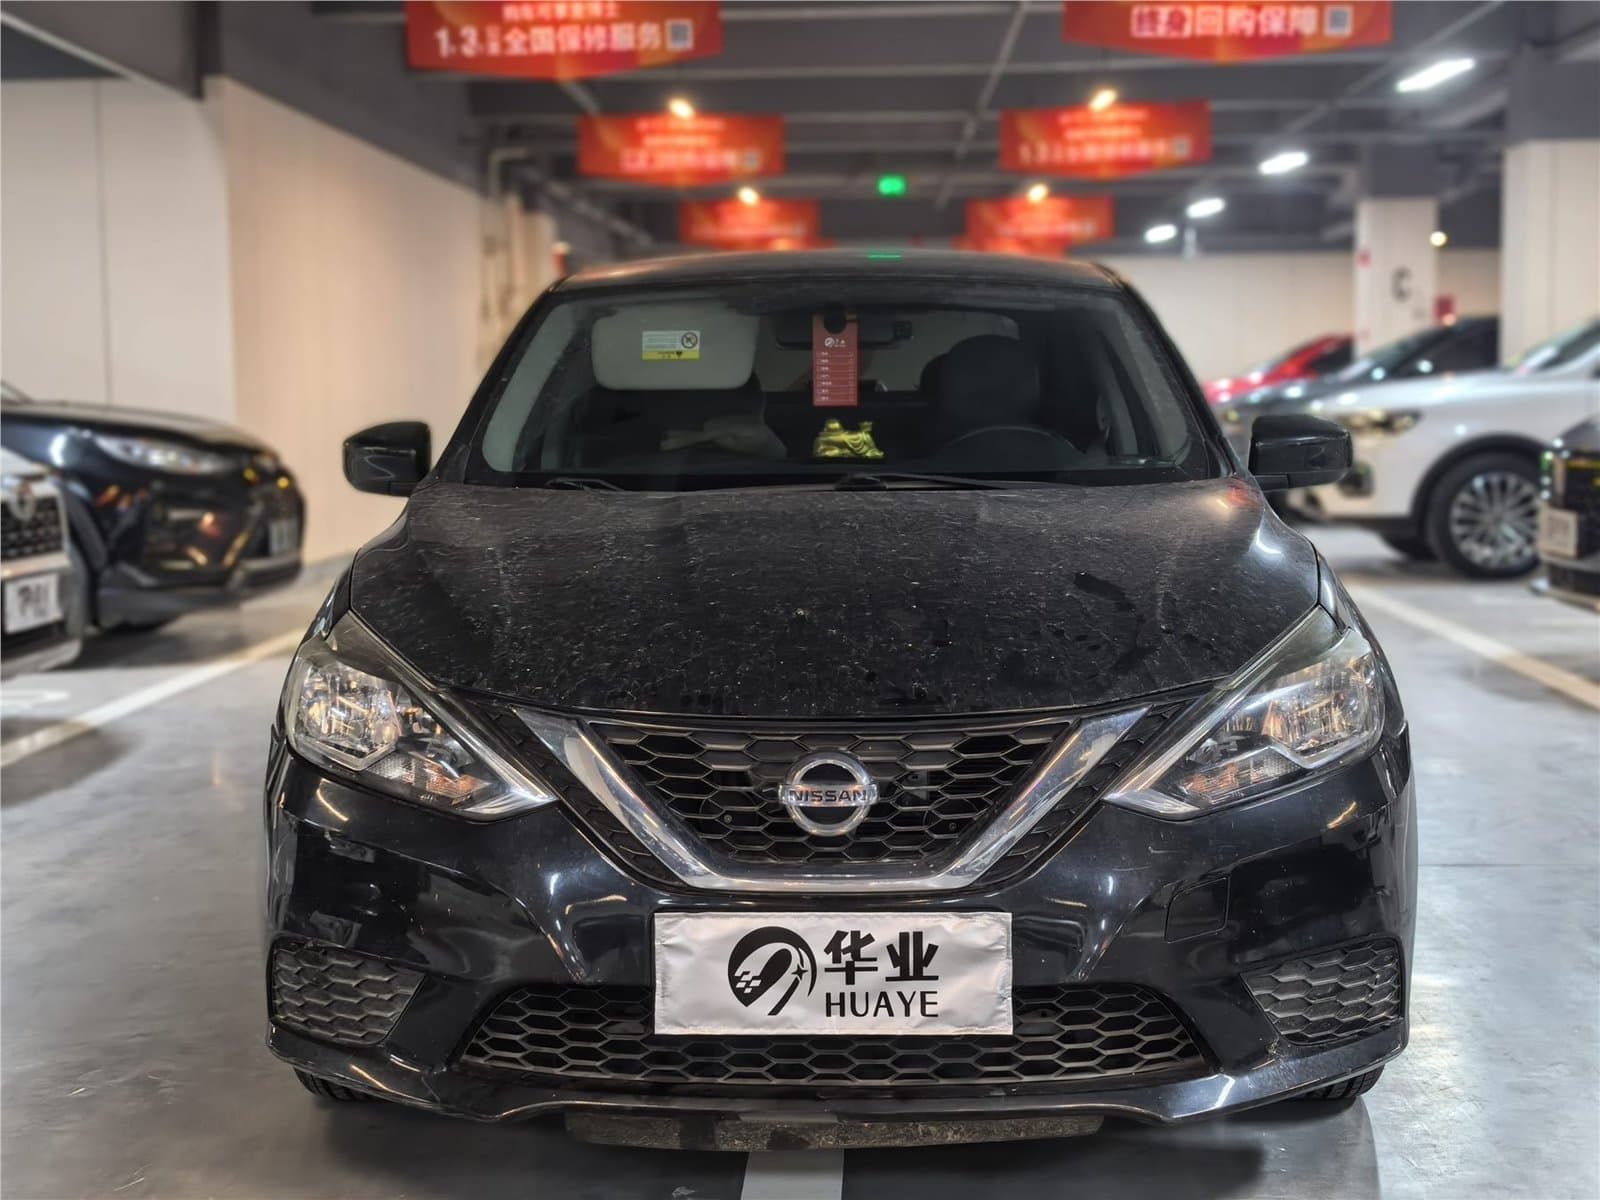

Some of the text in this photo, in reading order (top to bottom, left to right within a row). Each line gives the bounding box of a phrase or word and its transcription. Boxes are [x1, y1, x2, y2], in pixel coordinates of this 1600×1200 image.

[789, 789, 867, 802] NISSAN
[824, 930, 940, 985] 华业
[825, 990, 940, 1017] HUAYE
